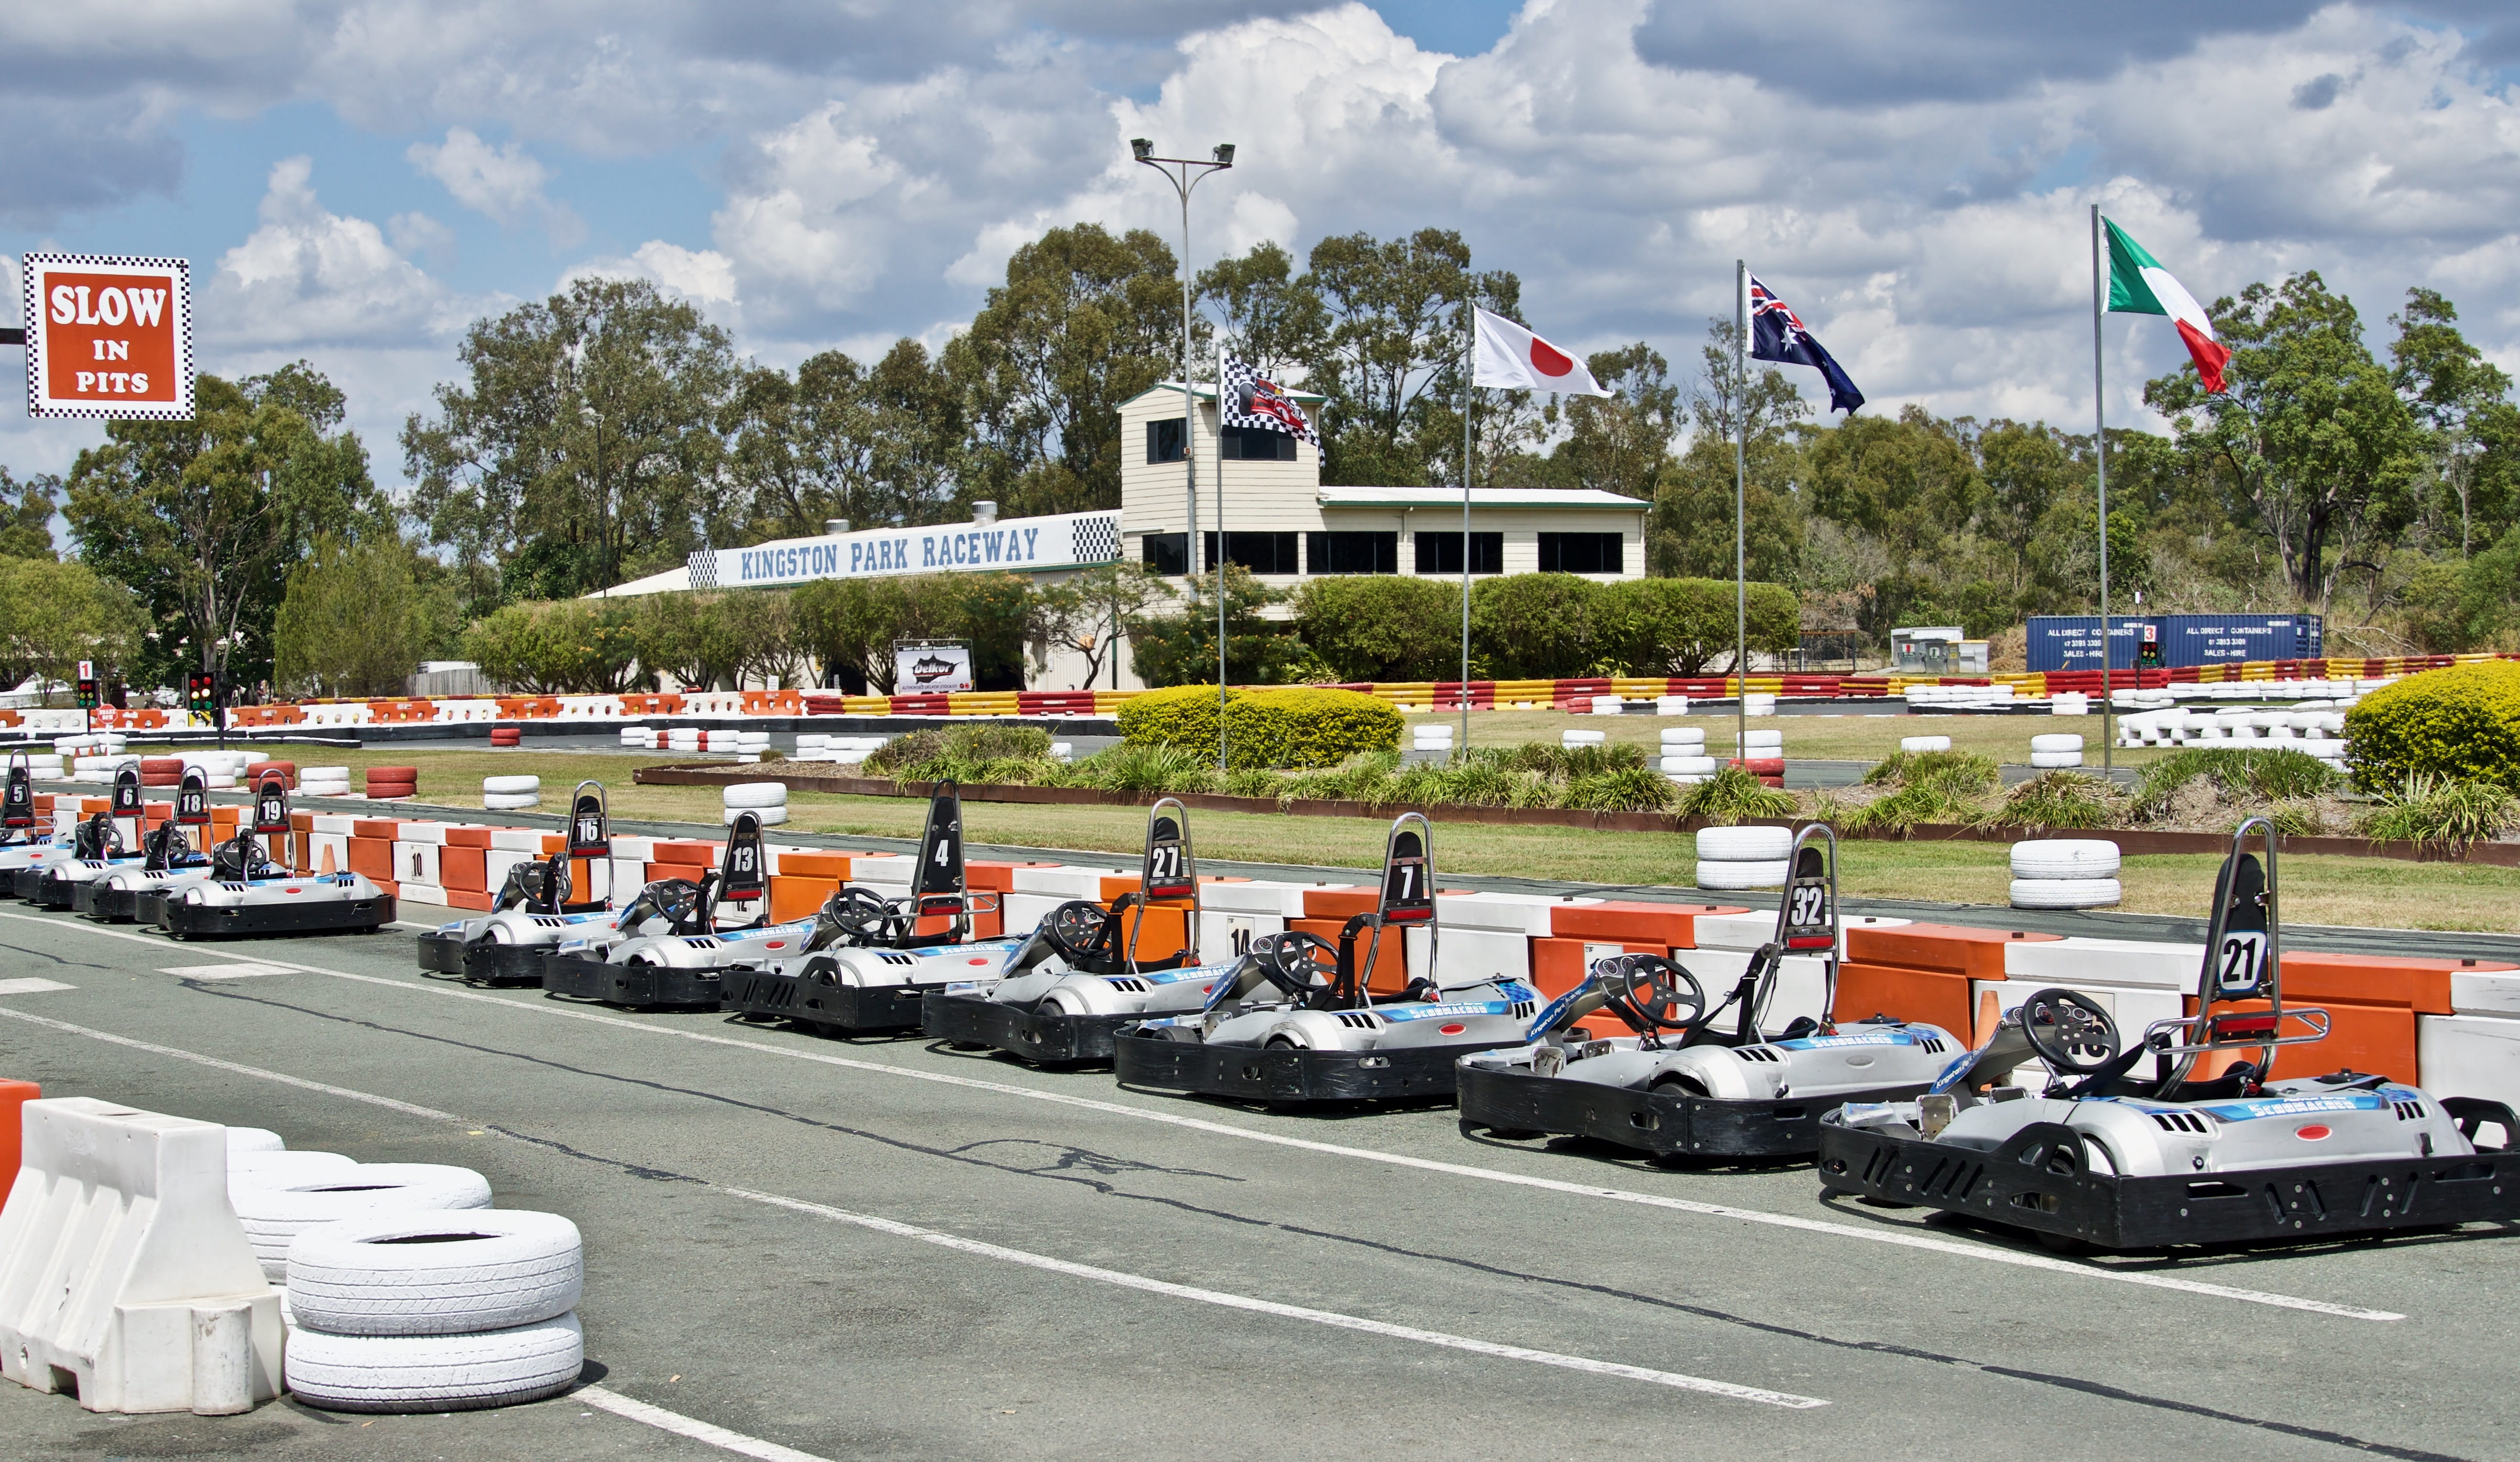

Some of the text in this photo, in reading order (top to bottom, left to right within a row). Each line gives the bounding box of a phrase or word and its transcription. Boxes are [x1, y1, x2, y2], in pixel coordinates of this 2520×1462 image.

[51, 285, 167, 327] SLOW
[93, 340, 129, 360] IN
[75, 372, 149, 393] PITS
[741, 528, 1038, 580] KINGSTON PARK RACEWAY
[2145, 627, 2154, 640] 3
[82, 664, 88, 677] 1
[915, 663, 951, 673] Delkor
[14, 786, 23, 802] 5
[123, 788, 133, 805] 6
[183, 795, 201, 812] 18
[262, 801, 280, 820] 19
[577, 820, 598, 841] 16
[732, 847, 754, 871] 13
[935, 839, 948, 866] 4
[1152, 847, 1178, 877] 27
[412, 853, 422, 876] 10
[1401, 866, 1413, 899] 7
[1791, 887, 1823, 925] 32
[1231, 929, 1249, 957] 14
[2223, 938, 2256, 983] 21
[1206, 987, 1223, 1004] Kingston
[1530, 1014, 1554, 1037] Kingston
[1554, 1003, 1565, 1016] Park
[1936, 1066, 1961, 1089] Kingston
[1961, 1055, 1972, 1070] Park
